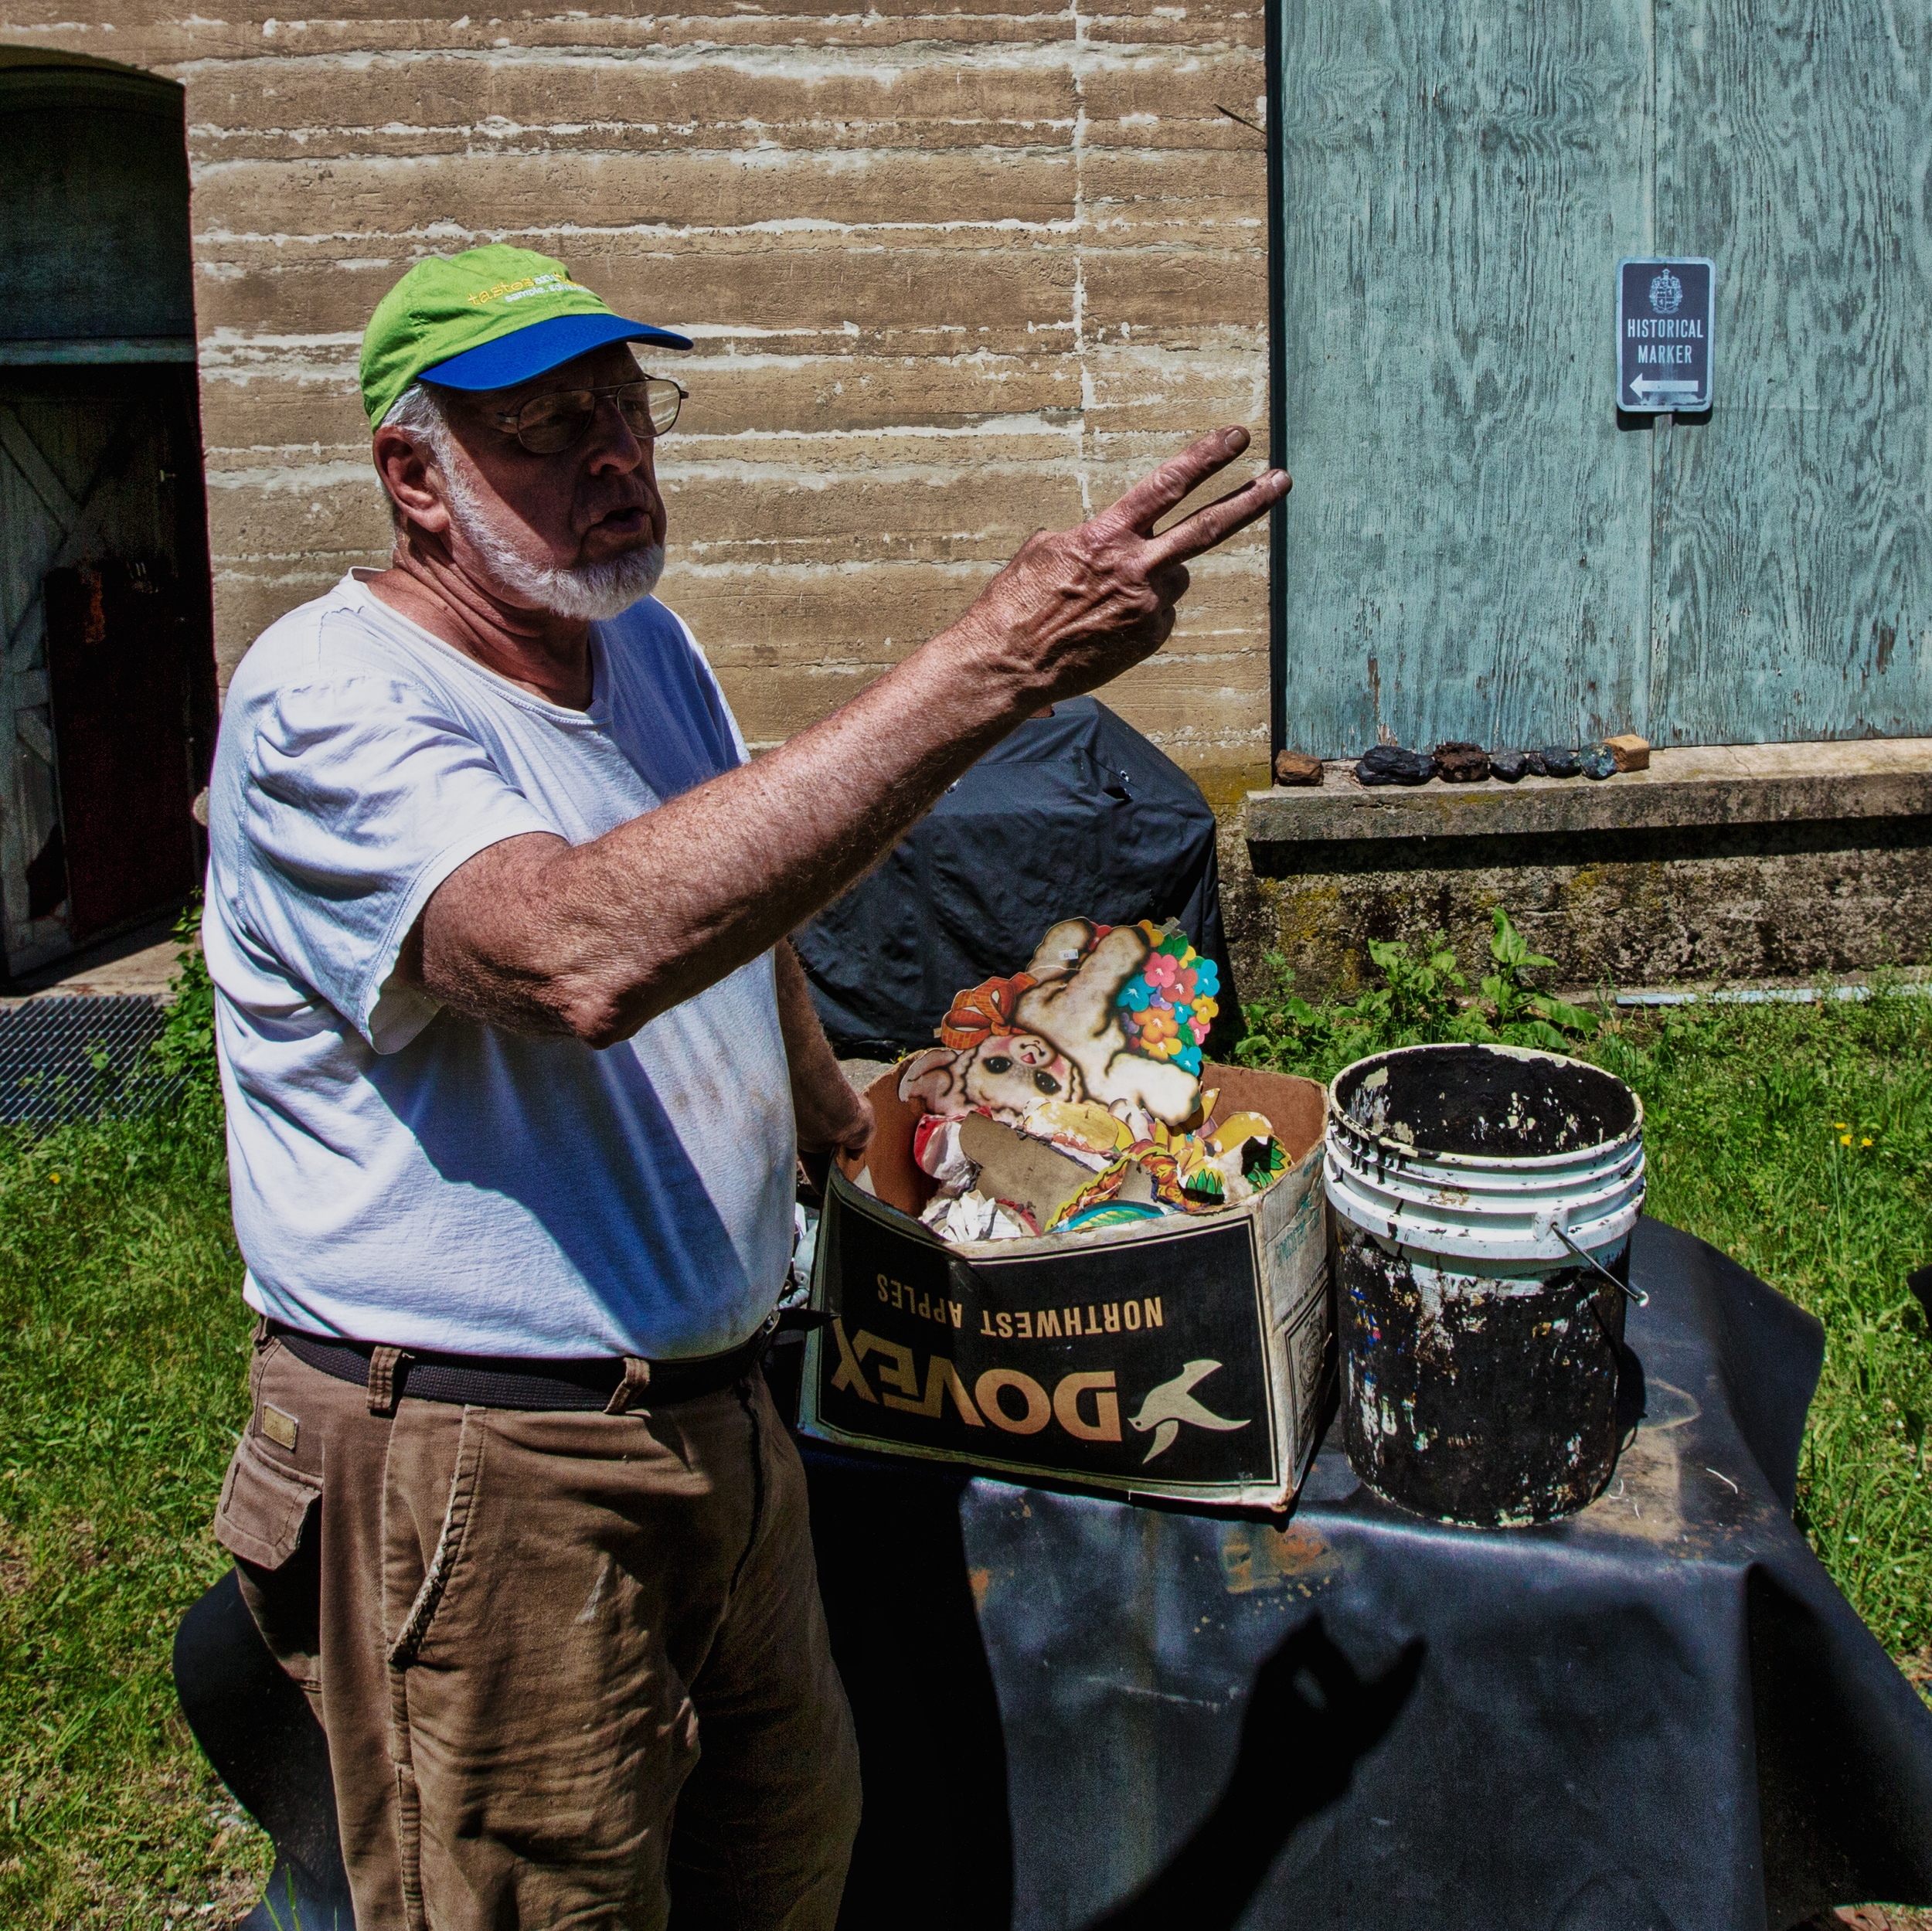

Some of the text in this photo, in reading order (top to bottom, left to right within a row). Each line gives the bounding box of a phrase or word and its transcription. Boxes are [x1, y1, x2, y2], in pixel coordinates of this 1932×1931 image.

[1627, 318, 1704, 338] HISTORICAL
[1638, 345, 1692, 364] MARKER
[877, 1273, 1164, 1338] NORTHWEST APPLES
[831, 1308, 1123, 1442] DOVEX
